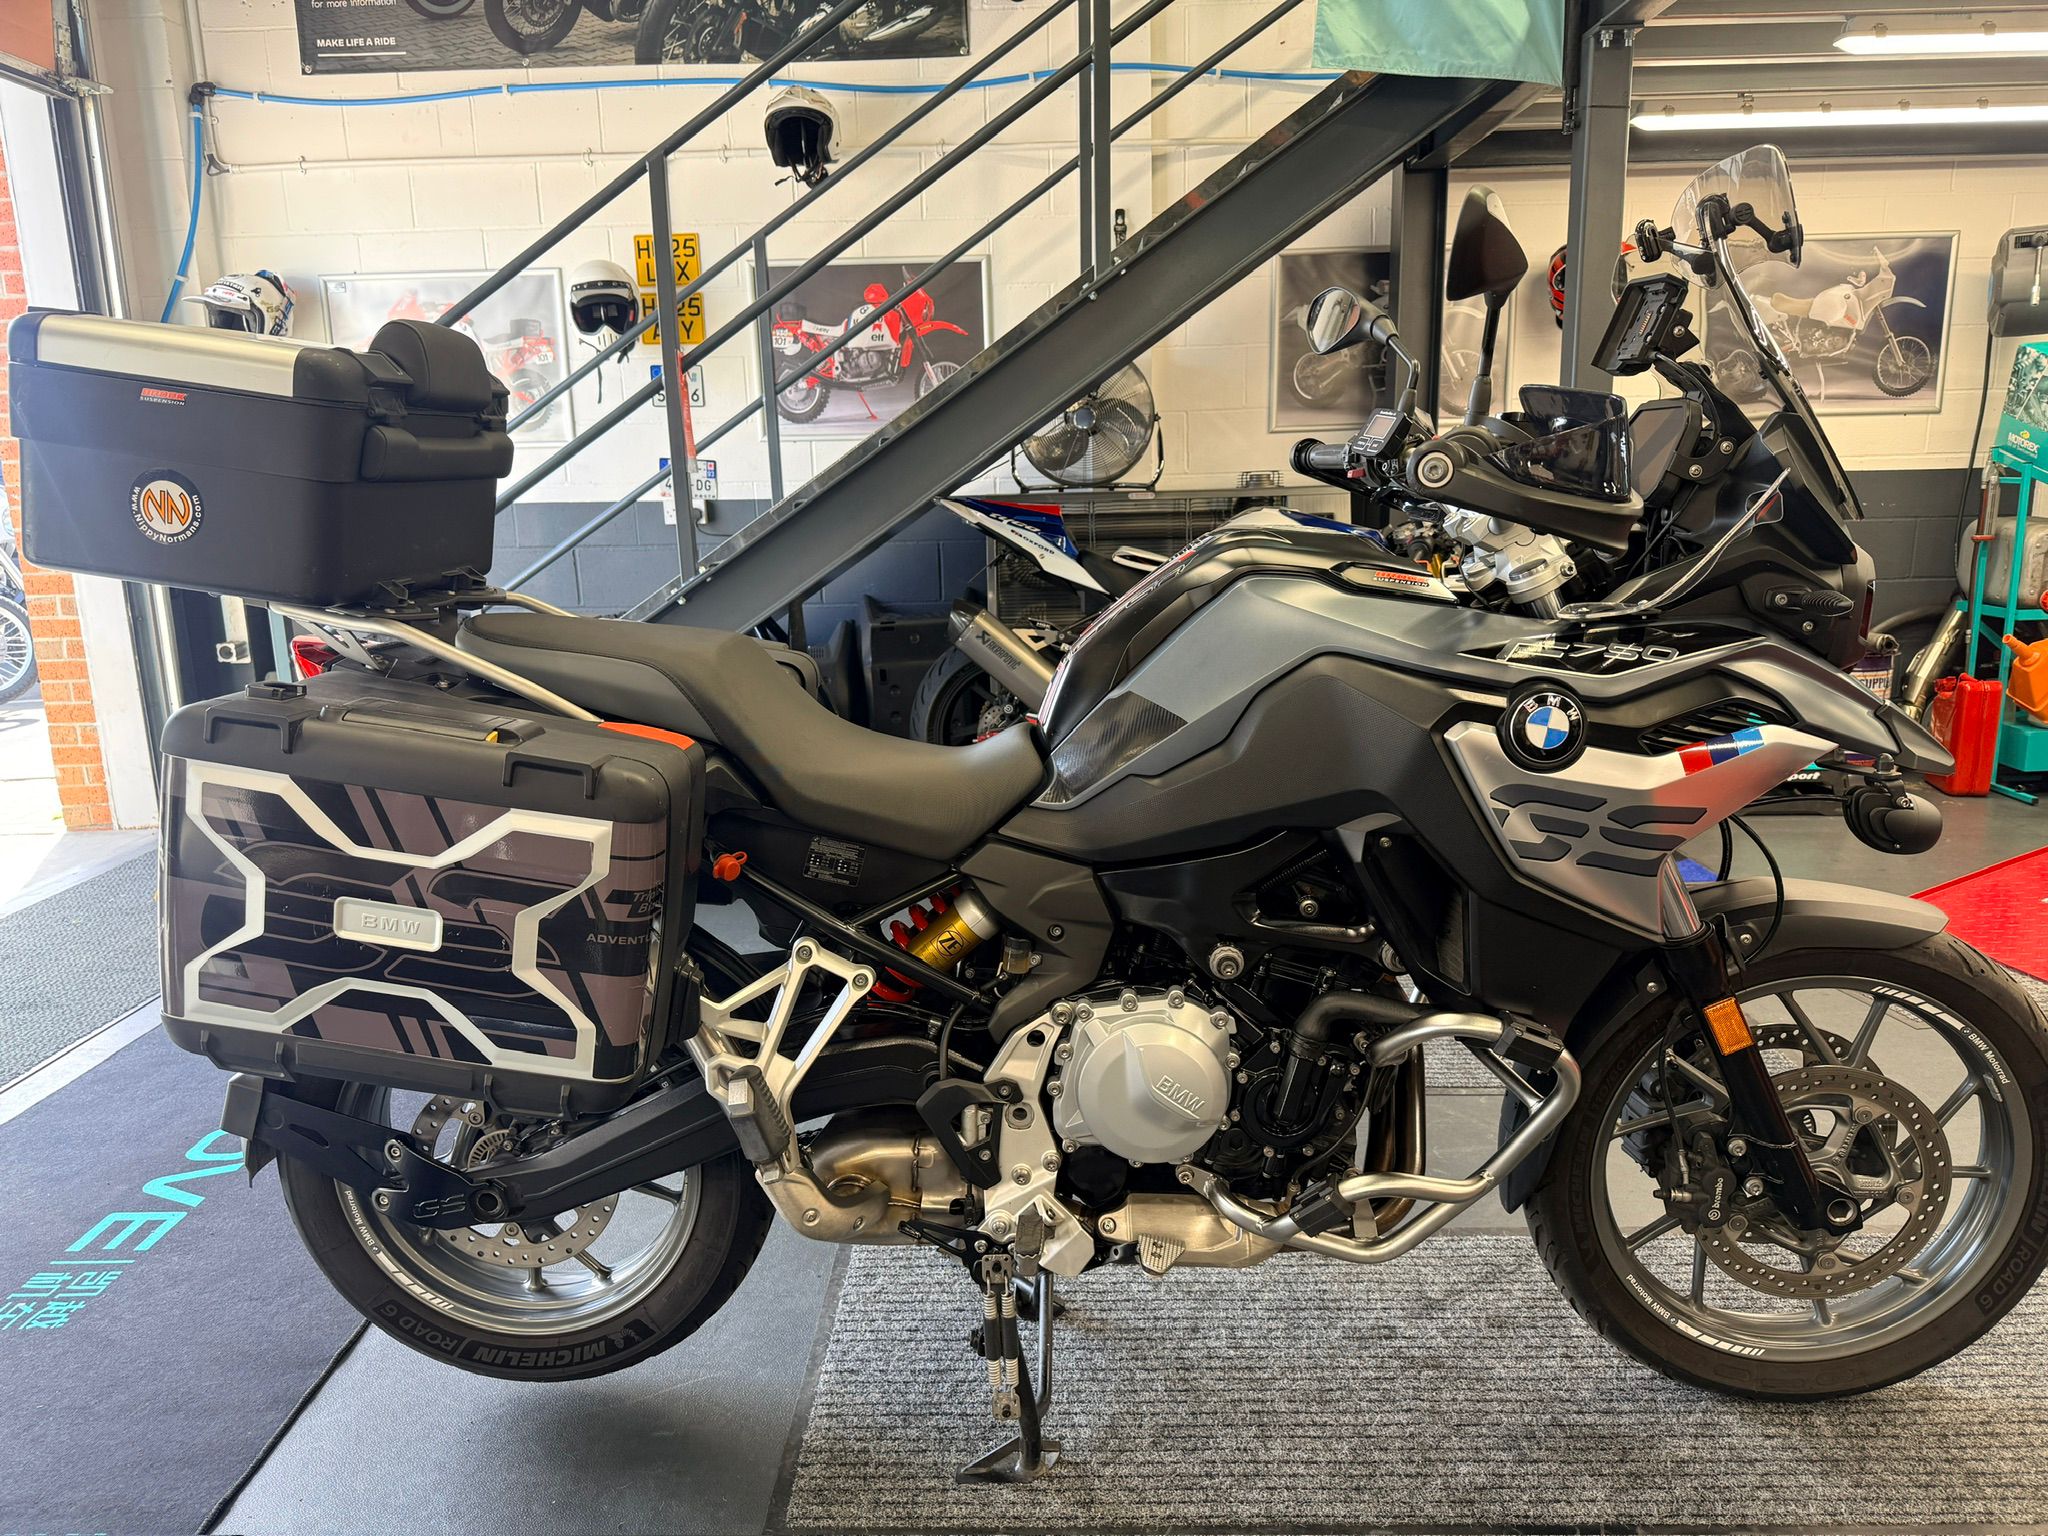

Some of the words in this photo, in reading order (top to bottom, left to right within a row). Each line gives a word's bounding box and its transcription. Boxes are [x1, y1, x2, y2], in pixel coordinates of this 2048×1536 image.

[311, 0, 323, 8] for
[326, 0, 348, 8] more
[317, 39, 344, 47] MAKE
[346, 38, 365, 46] LIFE
[366, 38, 373, 46] A
[374, 37, 396, 46] RIDE
[637, 238, 696, 259] H25
[646, 261, 690, 282] LX
[774, 337, 788, 345] 101
[871, 333, 885, 342] elf
[140, 397, 185, 406] SUSPENSION
[131, 486, 202, 543] www.NippyNormans.com
[1373, 577, 1430, 587] SUSPENSION
[1523, 694, 1580, 722] BMW
[361, 912, 420, 935] BMW
[938, 930, 963, 956] ZF
[1968, 1033, 1989, 1051] BMW
[1984, 1050, 2011, 1084] Motorrad
[1156, 1075, 1205, 1111] BMW
[1711, 1177, 1724, 1208] brembo
[344, 1190, 364, 1226] Motorrad
[413, 1194, 466, 1219] GS
[358, 1225, 376, 1247] BMW
[1625, 1274, 1654, 1305] Motorrad
[383, 1304, 398, 1316] 6
[1651, 1302, 1671, 1320] BMW
[399, 1315, 458, 1351] ROAD
[472, 1340, 607, 1368] MICHELIN
